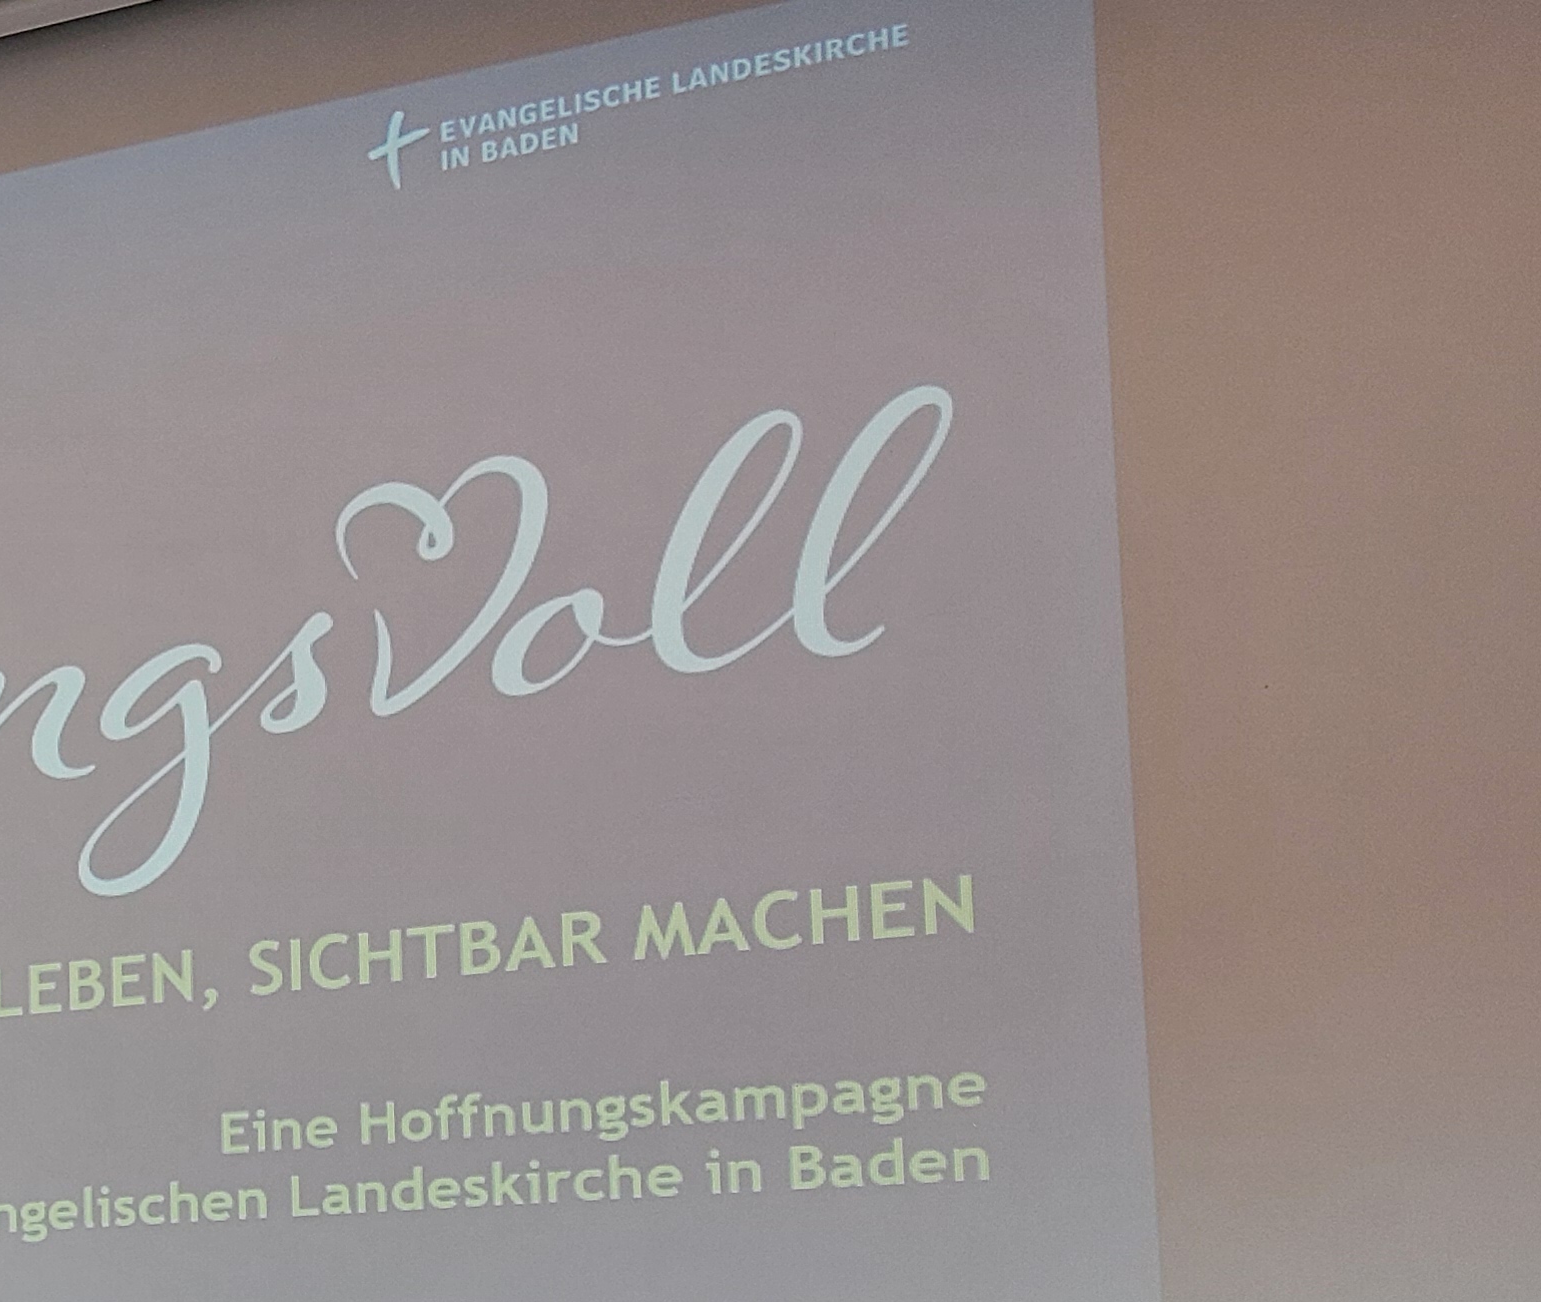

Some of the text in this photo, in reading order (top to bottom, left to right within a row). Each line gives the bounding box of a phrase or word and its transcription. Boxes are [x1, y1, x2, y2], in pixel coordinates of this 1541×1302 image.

[439, 22, 911, 143] EVANGELISCHE LANDESKIRCHE
[440, 122, 579, 171] IN BADEN
[248, 909, 610, 996] SICHTBAR
[632, 873, 976, 961] MACHEN
[219, 1071, 989, 1155] Eine Hoffnungskampagne
[290, 1153, 685, 1218] Landeskirche
[703, 1147, 764, 1195] in
[787, 1136, 991, 1191] Baden
